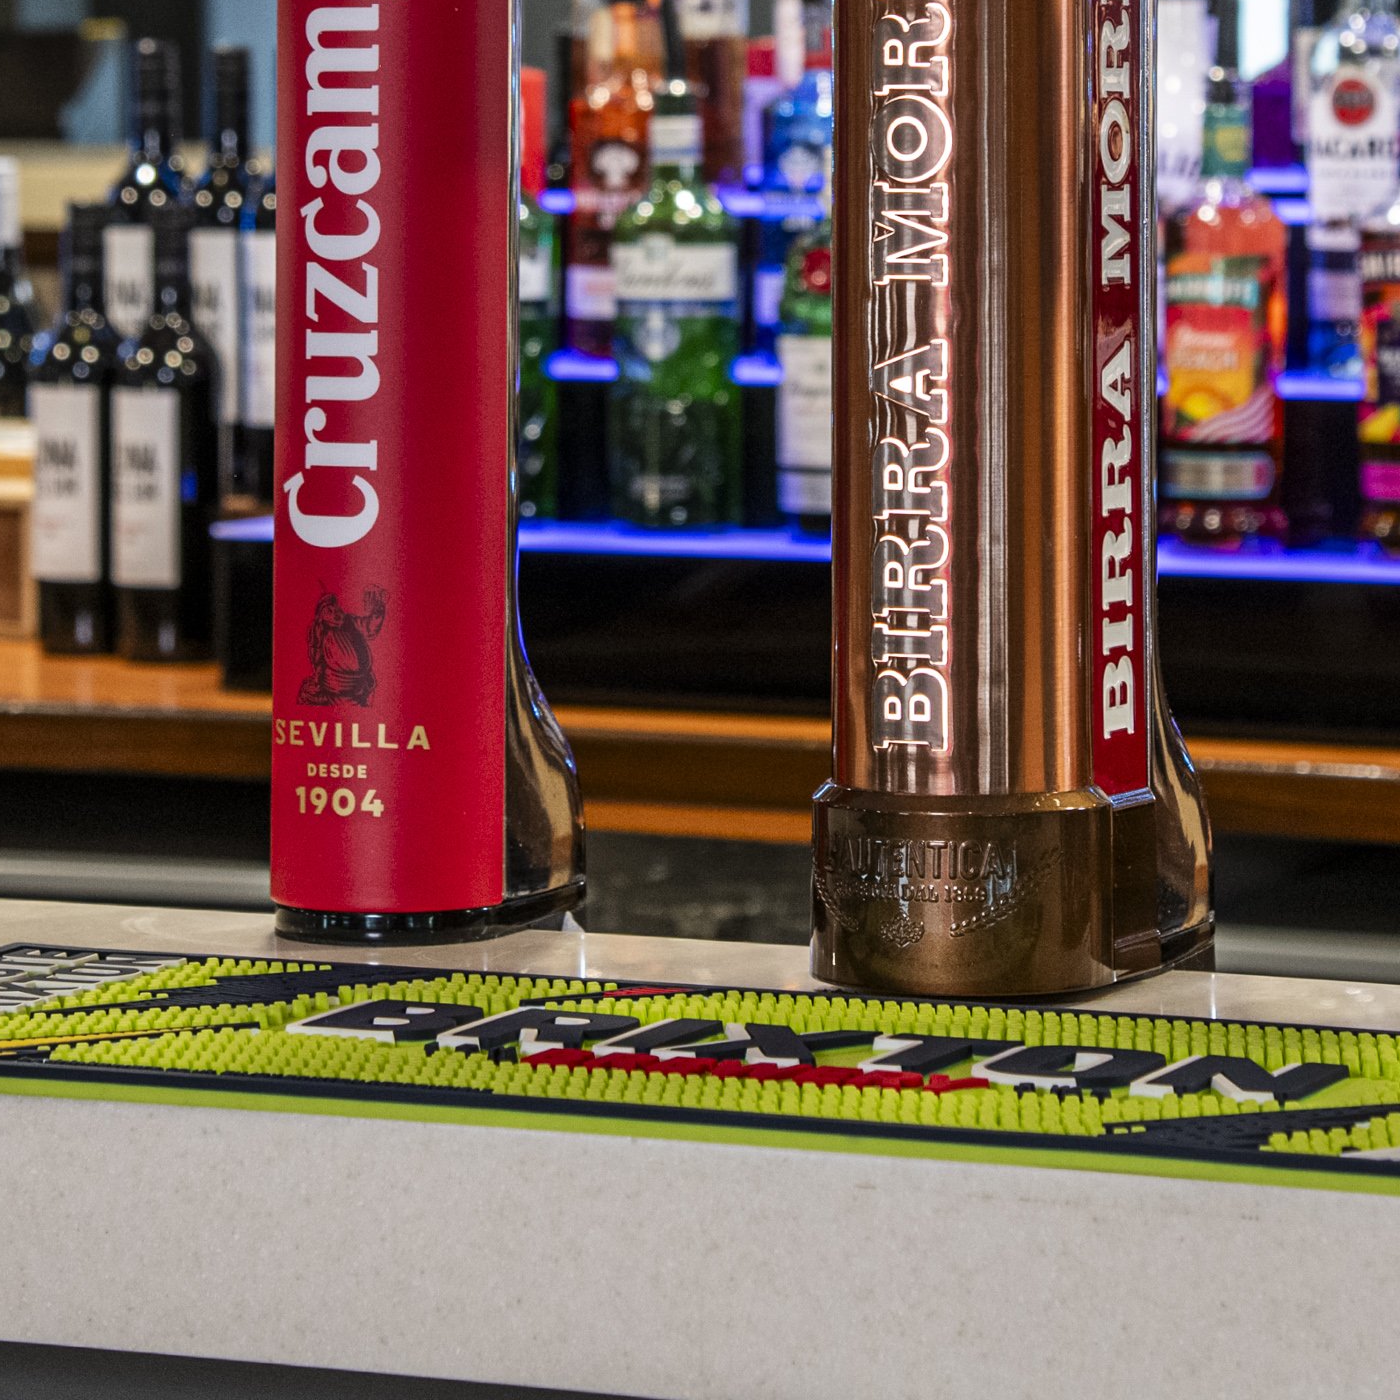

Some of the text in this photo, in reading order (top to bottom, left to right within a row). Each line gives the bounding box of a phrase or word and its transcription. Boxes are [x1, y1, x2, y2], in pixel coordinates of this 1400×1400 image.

[873, 337, 953, 753] BIRRA
[1101, 339, 1133, 739] BIRRA
[275, 718, 431, 750] SEVILLA
[295, 786, 385, 818] 1904
[307, 763, 368, 779] DESDE
[284, 998, 1350, 1105] BRIXTON
